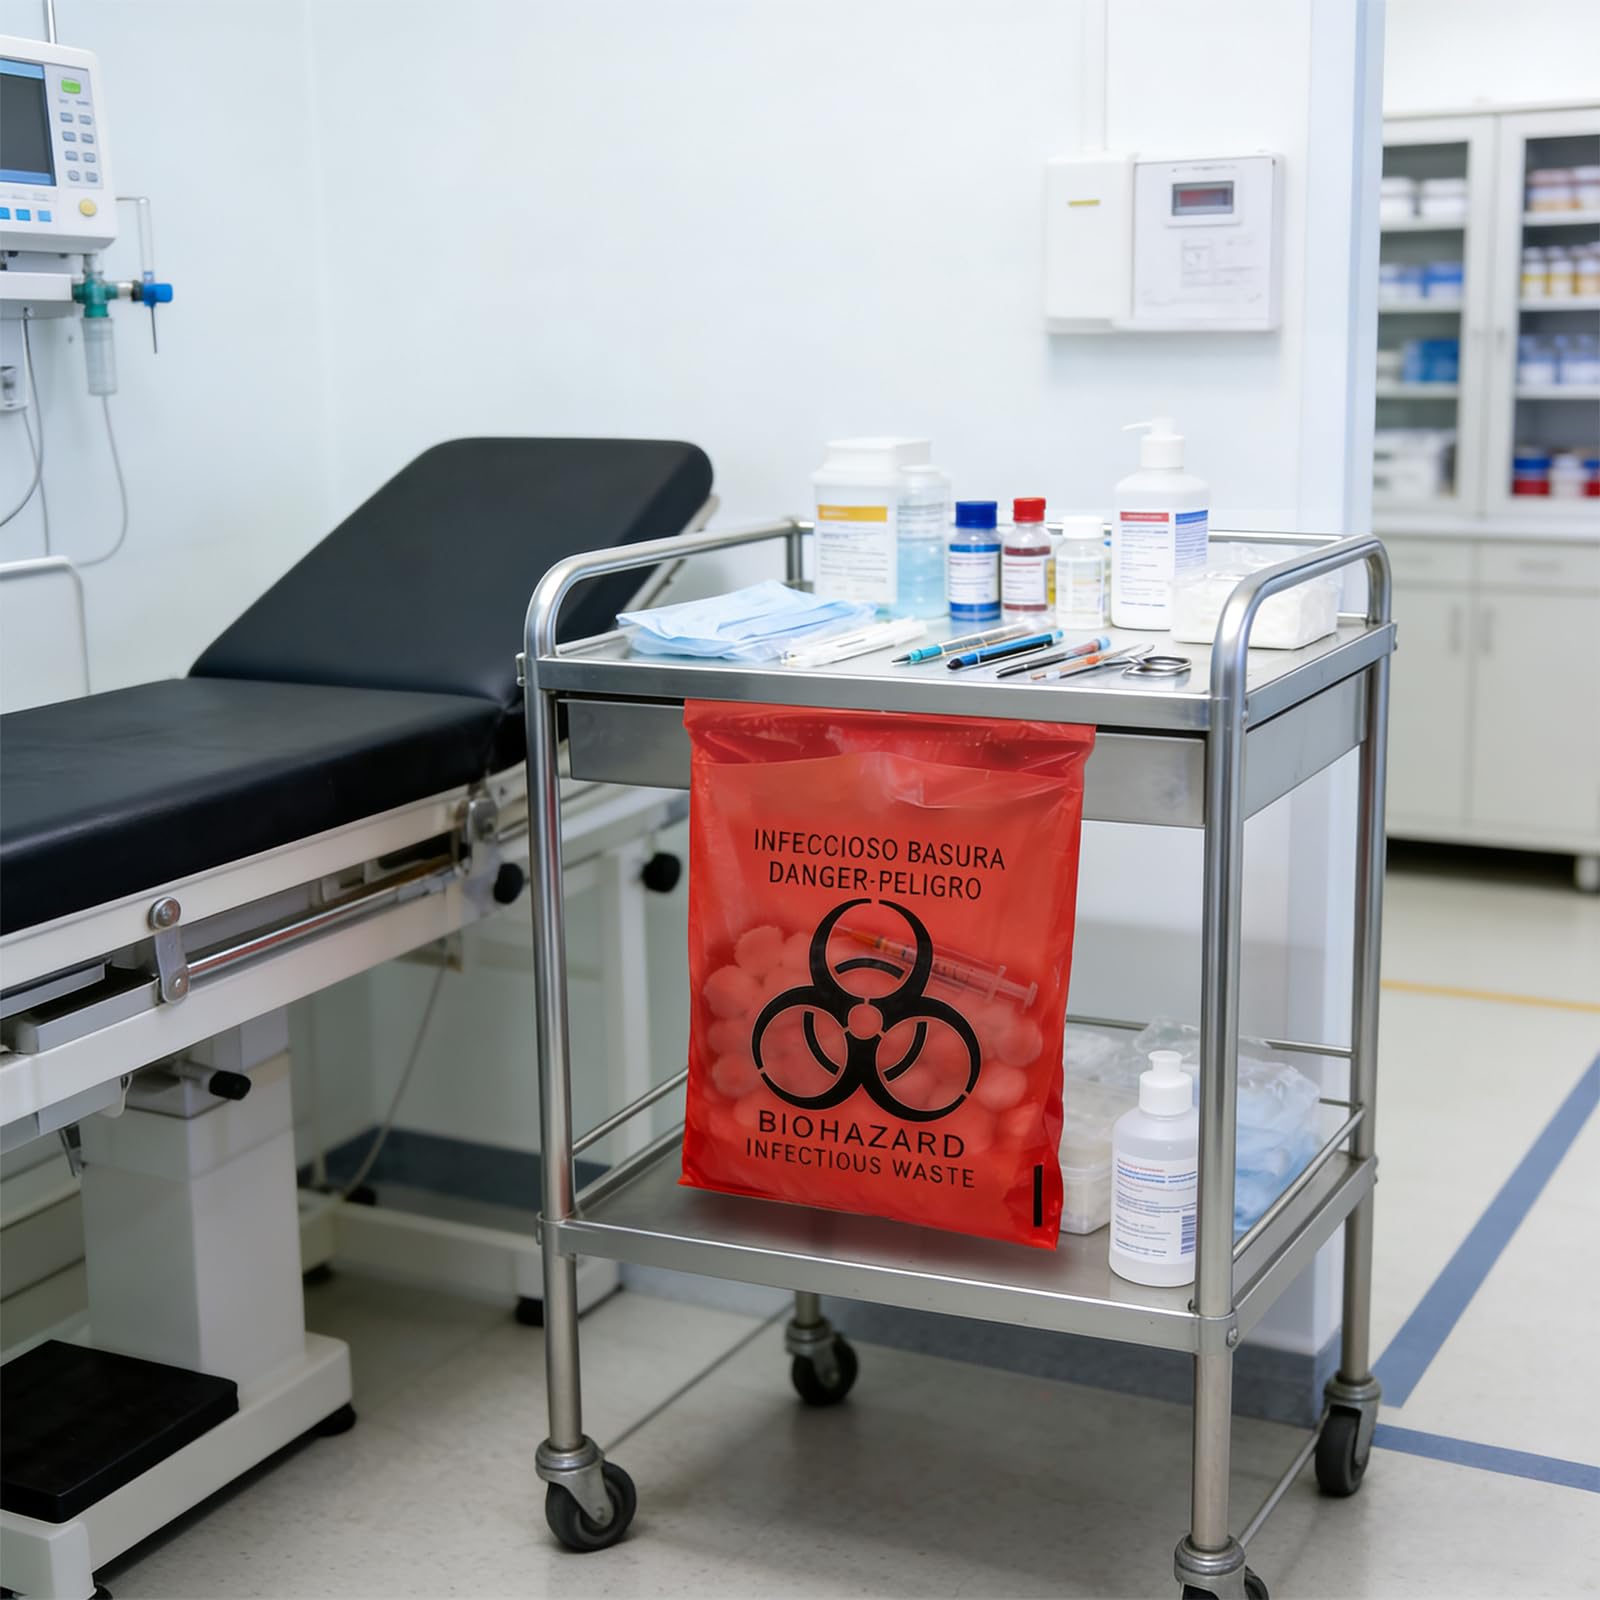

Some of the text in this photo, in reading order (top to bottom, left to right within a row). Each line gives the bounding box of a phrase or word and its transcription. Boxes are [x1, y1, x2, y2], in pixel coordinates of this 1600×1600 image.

[754, 828, 1006, 871] INFECCIOSO BASURA
[769, 860, 982, 901] DANGER-PELIGRO
[759, 1108, 965, 1160] BIOHAZARD
[746, 1136, 975, 1189] INFECTIOUS WASTE
